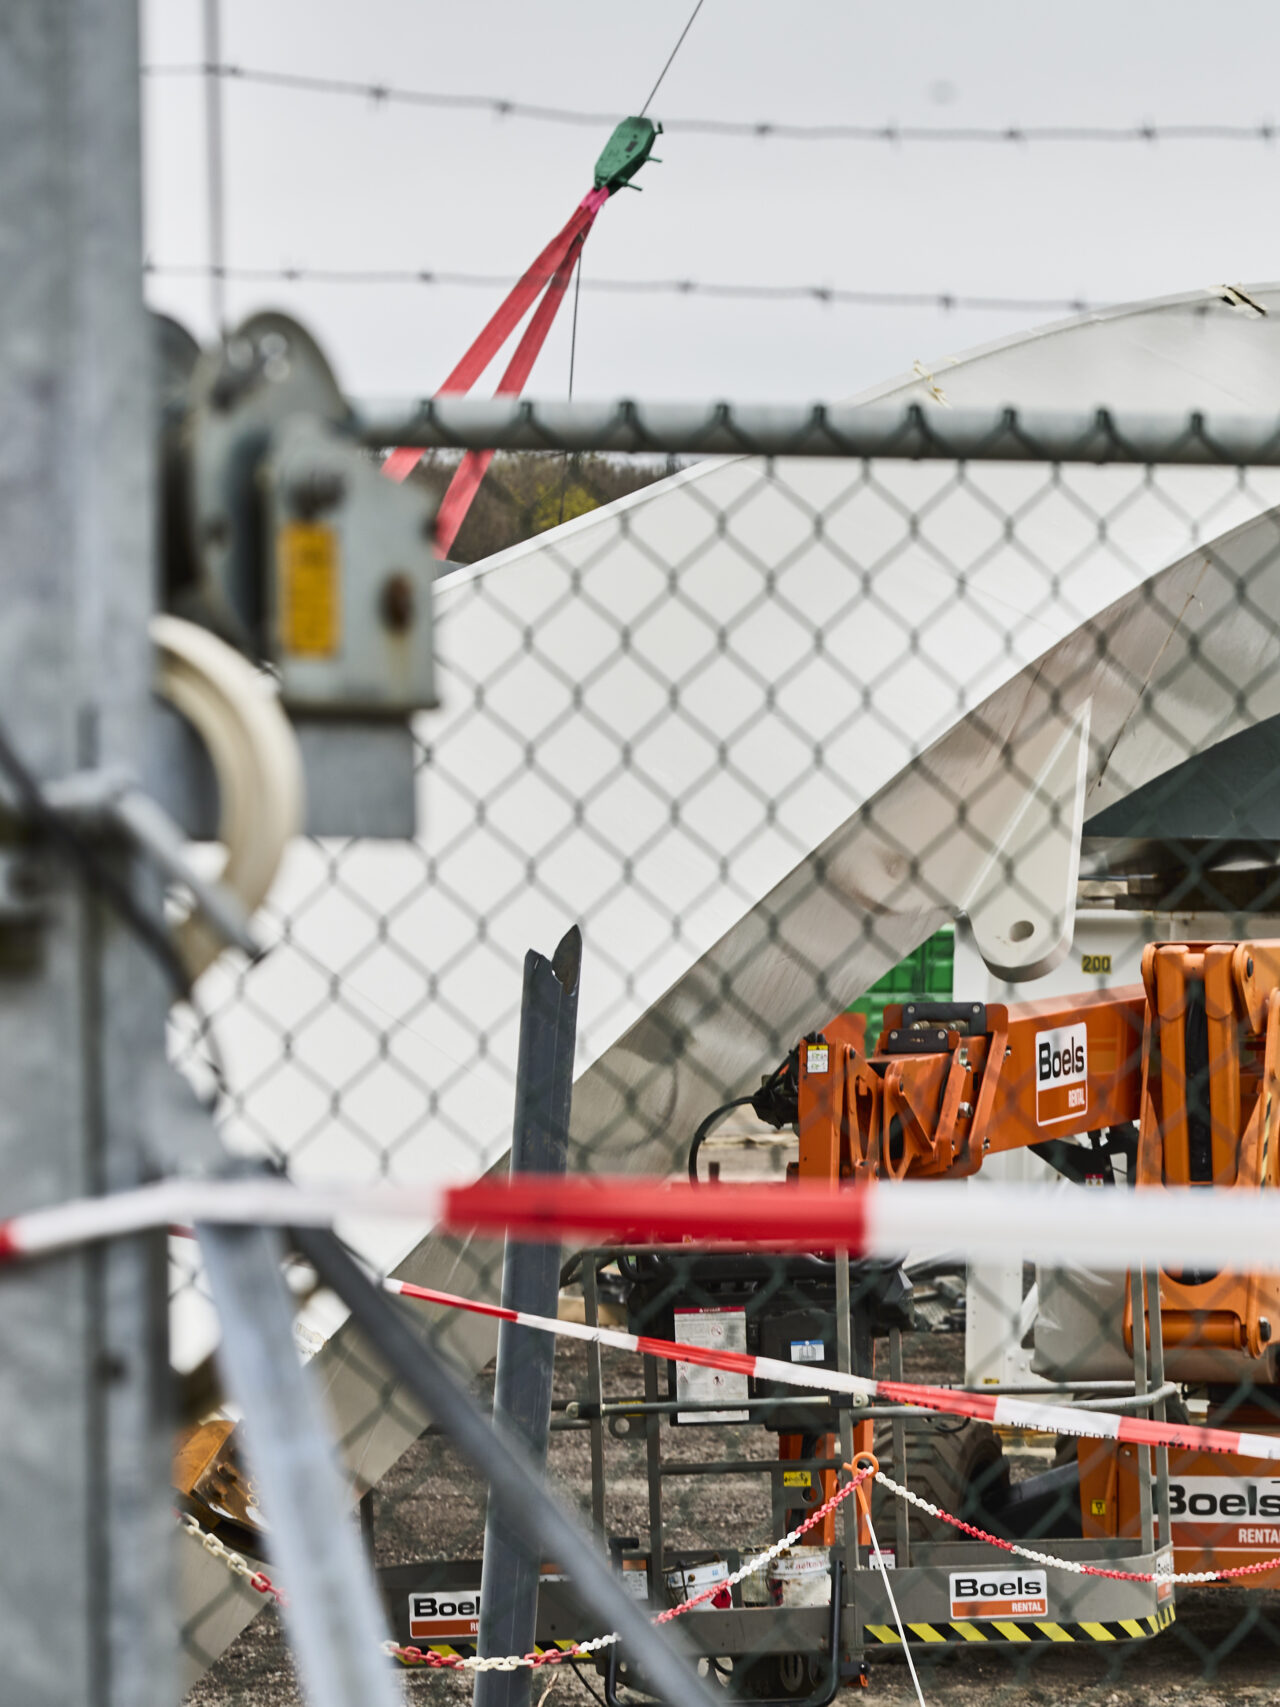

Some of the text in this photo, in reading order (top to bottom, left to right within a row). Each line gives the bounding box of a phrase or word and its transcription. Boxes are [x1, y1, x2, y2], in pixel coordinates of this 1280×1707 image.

[1083, 956, 1111, 973] 200
[1039, 1036, 1085, 1081] Boels
[954, 1576, 1042, 1598] Boels
[413, 1596, 481, 1617] Boel
[1011, 1602, 1043, 1614] RENTAL
